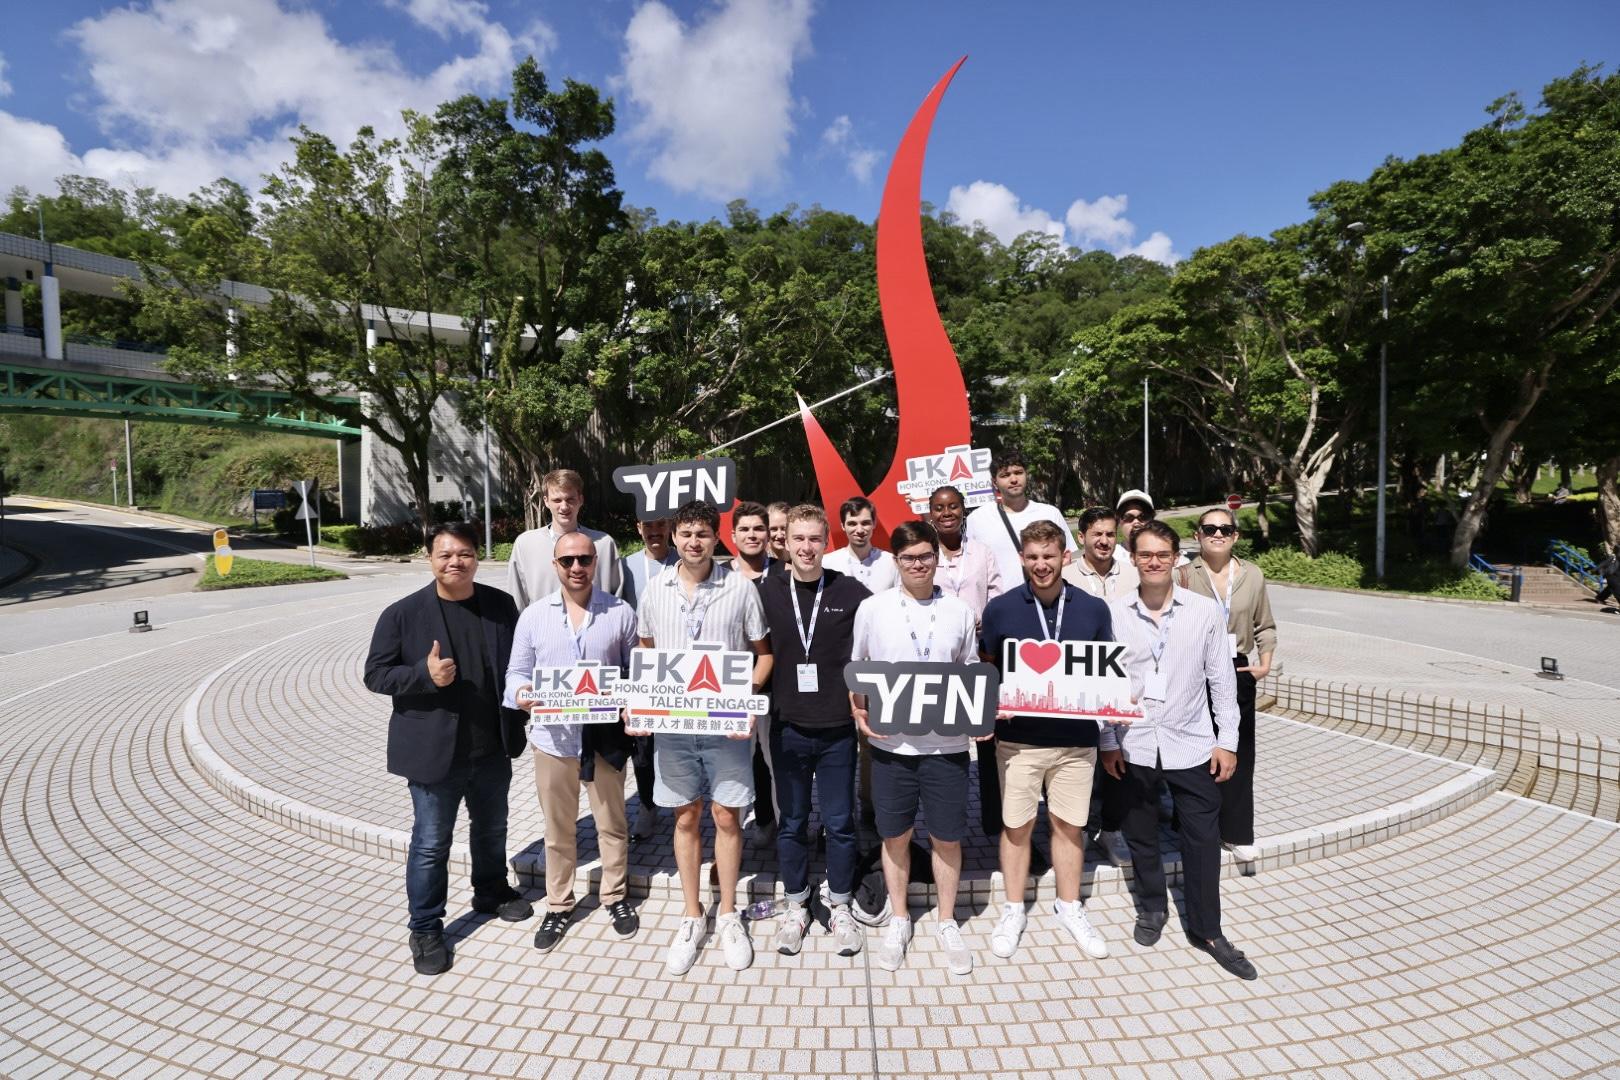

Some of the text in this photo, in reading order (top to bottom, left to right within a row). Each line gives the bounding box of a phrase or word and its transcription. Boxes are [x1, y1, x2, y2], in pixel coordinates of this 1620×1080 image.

[622, 466, 727, 512] YFN
[900, 478, 948, 490] HONG KONG
[1007, 641, 1127, 678] I HK
[521, 691, 573, 699] HONG KONG
[614, 684, 684, 695] HONG KONG
[547, 699, 585, 708] TALENT
[649, 696, 765, 711] TALENT ENGAGE
[855, 673, 987, 725] YFN
[631, 717, 748, 732] 香港人才服務辦公室
